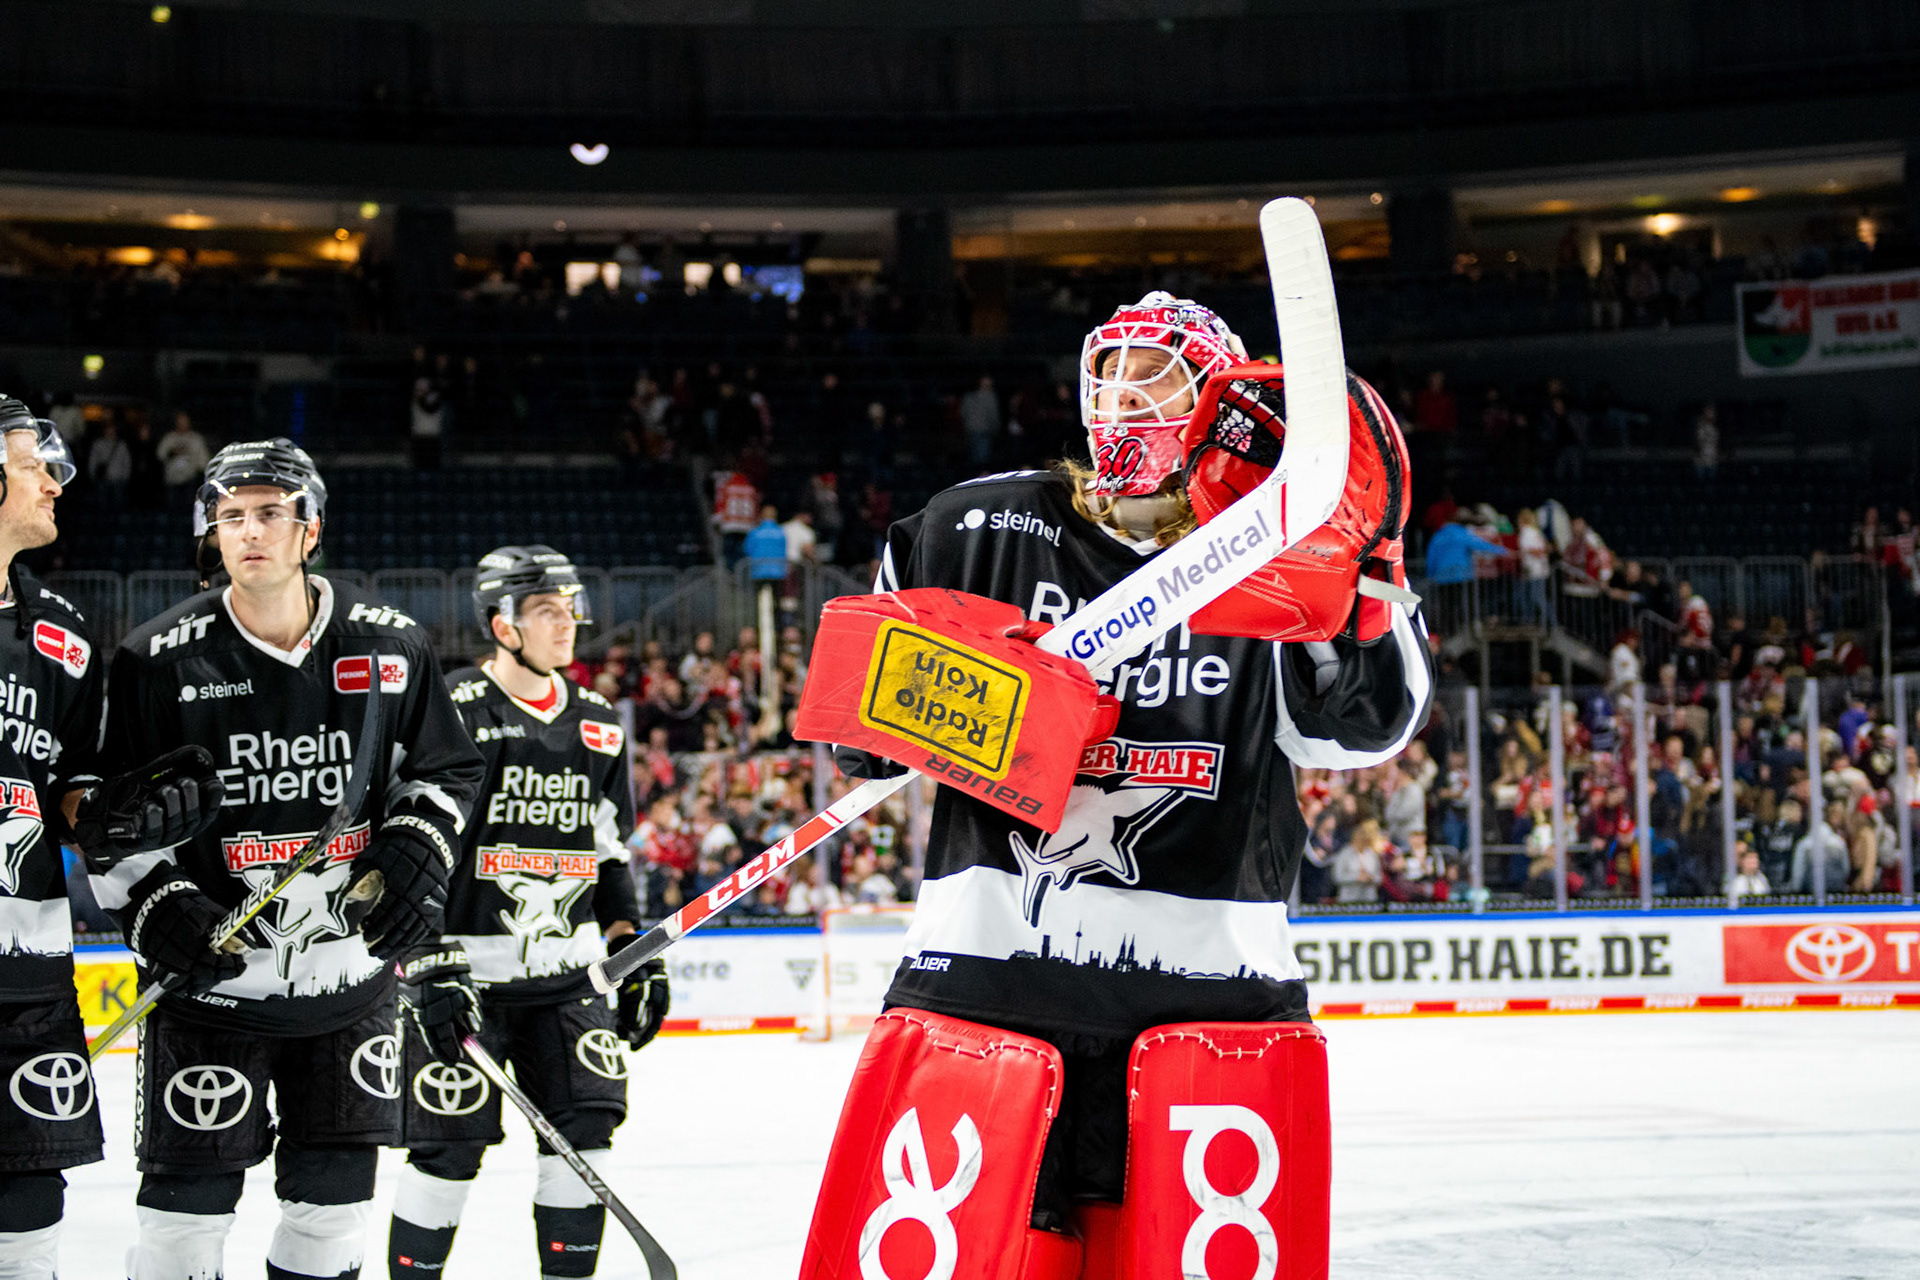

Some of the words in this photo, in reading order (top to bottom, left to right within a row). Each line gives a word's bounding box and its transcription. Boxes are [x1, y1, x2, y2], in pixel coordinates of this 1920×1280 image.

[1097, 436, 1146, 480] 30
[989, 509, 1062, 547] steinel
[1065, 596, 1156, 660] Group
[1156, 508, 1272, 604] Medical
[150, 613, 216, 656] HIT
[348, 603, 416, 629] HIT
[200, 679, 254, 700] steinel
[339, 670, 368, 680] PENNY
[915, 651, 989, 704] Köln
[896, 689, 988, 747] Radio
[229, 724, 352, 769] Rhein
[216, 765, 352, 806] Energ
[503, 765, 590, 798] Rhein
[926, 753, 1042, 815] BAUER
[1128, 749, 1216, 788] HAIE
[482, 849, 554, 873] KÖLNER
[707, 833, 795, 910] CCM
[131, 880, 200, 952] SHERWOO
[405, 950, 467, 979] BAUE
[1294, 933, 1671, 983] SHOP.HAIE.DE
[135, 1043, 145, 1148] TOYOTA
